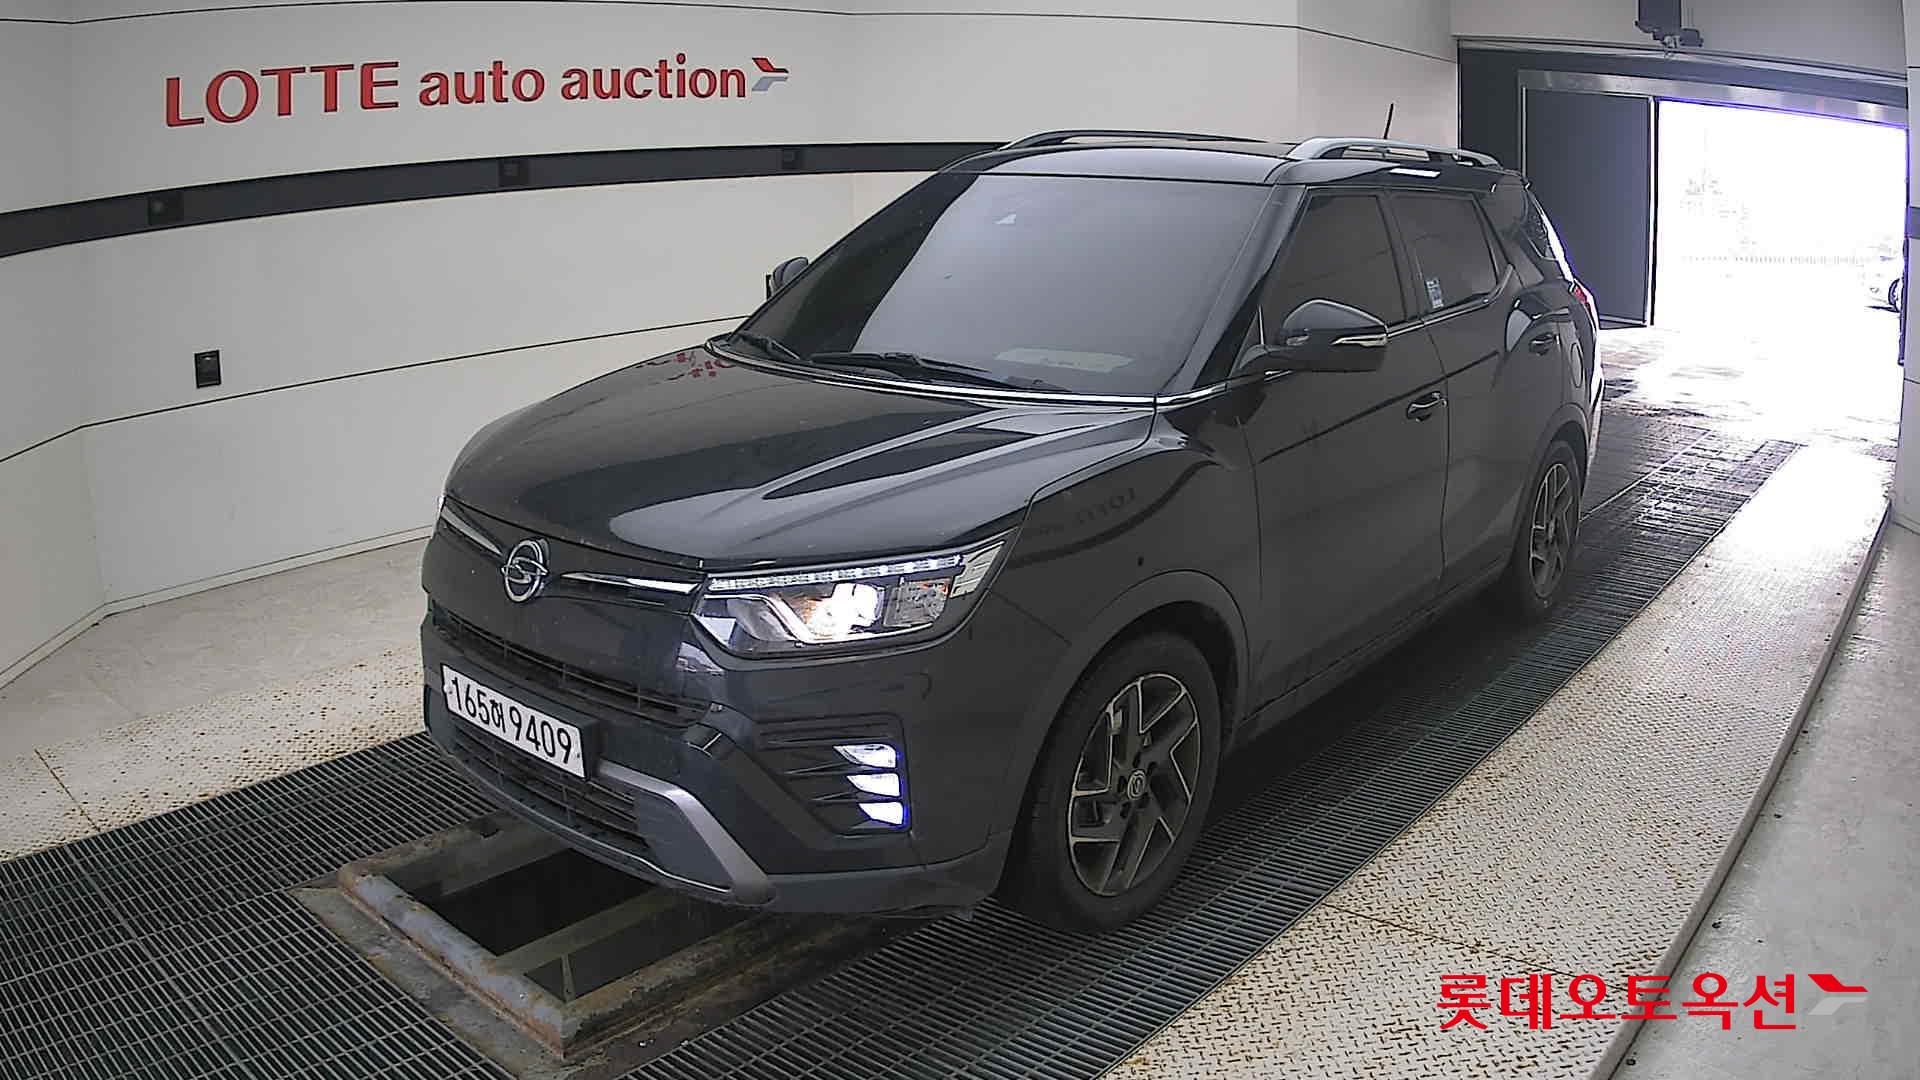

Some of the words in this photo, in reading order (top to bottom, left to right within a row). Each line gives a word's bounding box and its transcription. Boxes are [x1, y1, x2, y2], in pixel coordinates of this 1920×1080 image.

[166, 61, 399, 127] LOTTE
[419, 60, 545, 106] auto
[561, 53, 747, 100] auction
